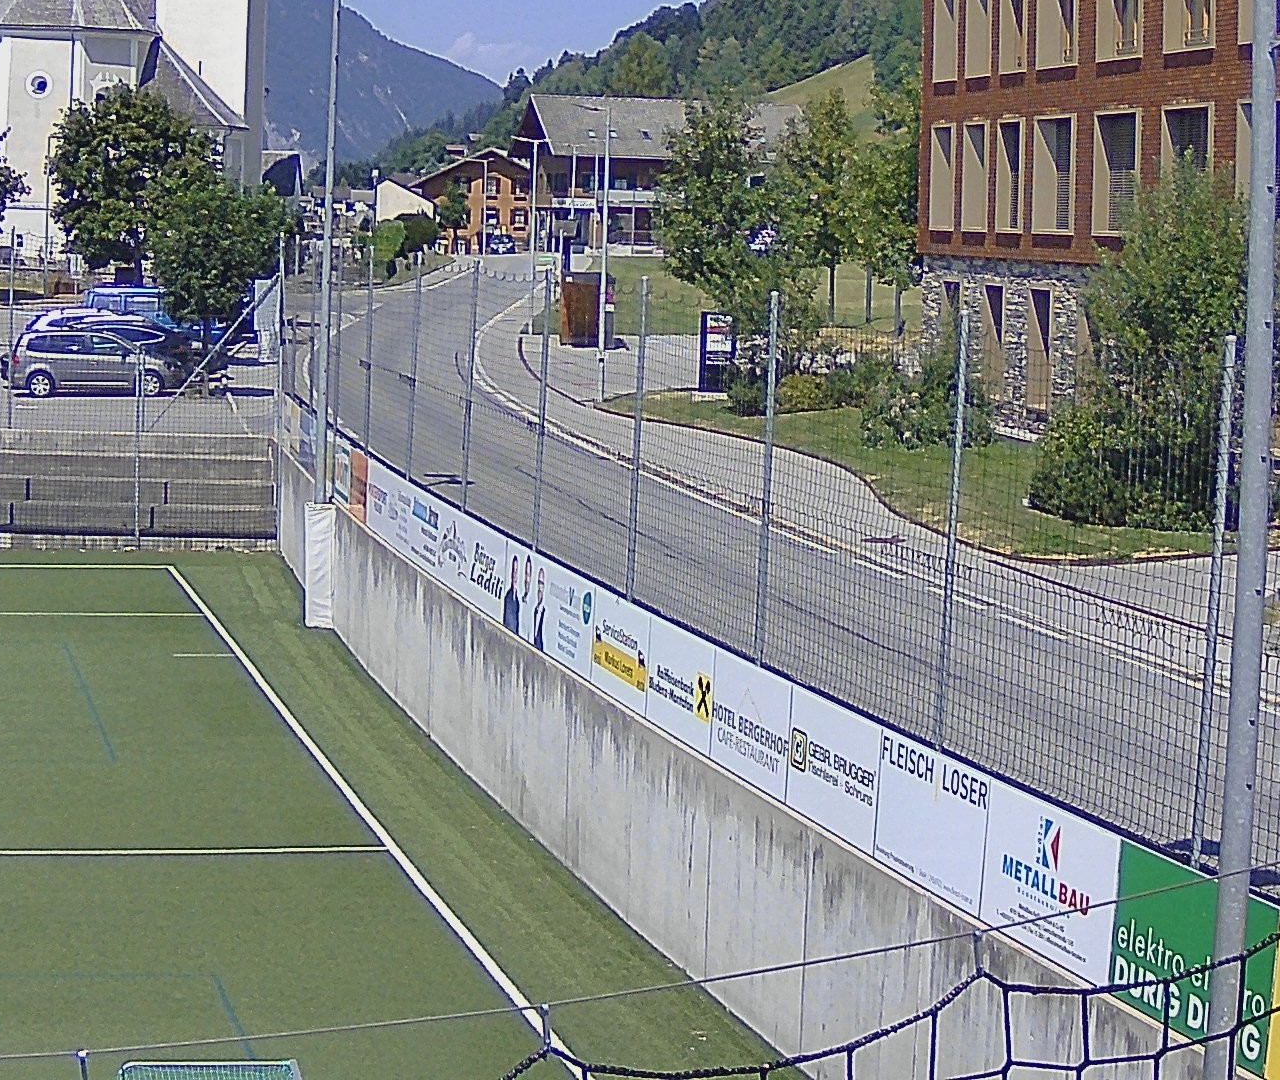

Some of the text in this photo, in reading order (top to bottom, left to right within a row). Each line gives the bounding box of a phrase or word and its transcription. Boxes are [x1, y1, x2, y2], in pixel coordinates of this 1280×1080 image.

[712, 700, 737, 730] HOTEL
[738, 715, 790, 758] BERGERHOF
[808, 740, 833, 768] GEBR.
[844, 782, 873, 807] Schruns
[881, 735, 988, 810] FLEISCH LOSER
[1002, 853, 1091, 916] METALLBAU
[1117, 918, 1186, 977] elektro
[1190, 955, 1265, 1018] elro
